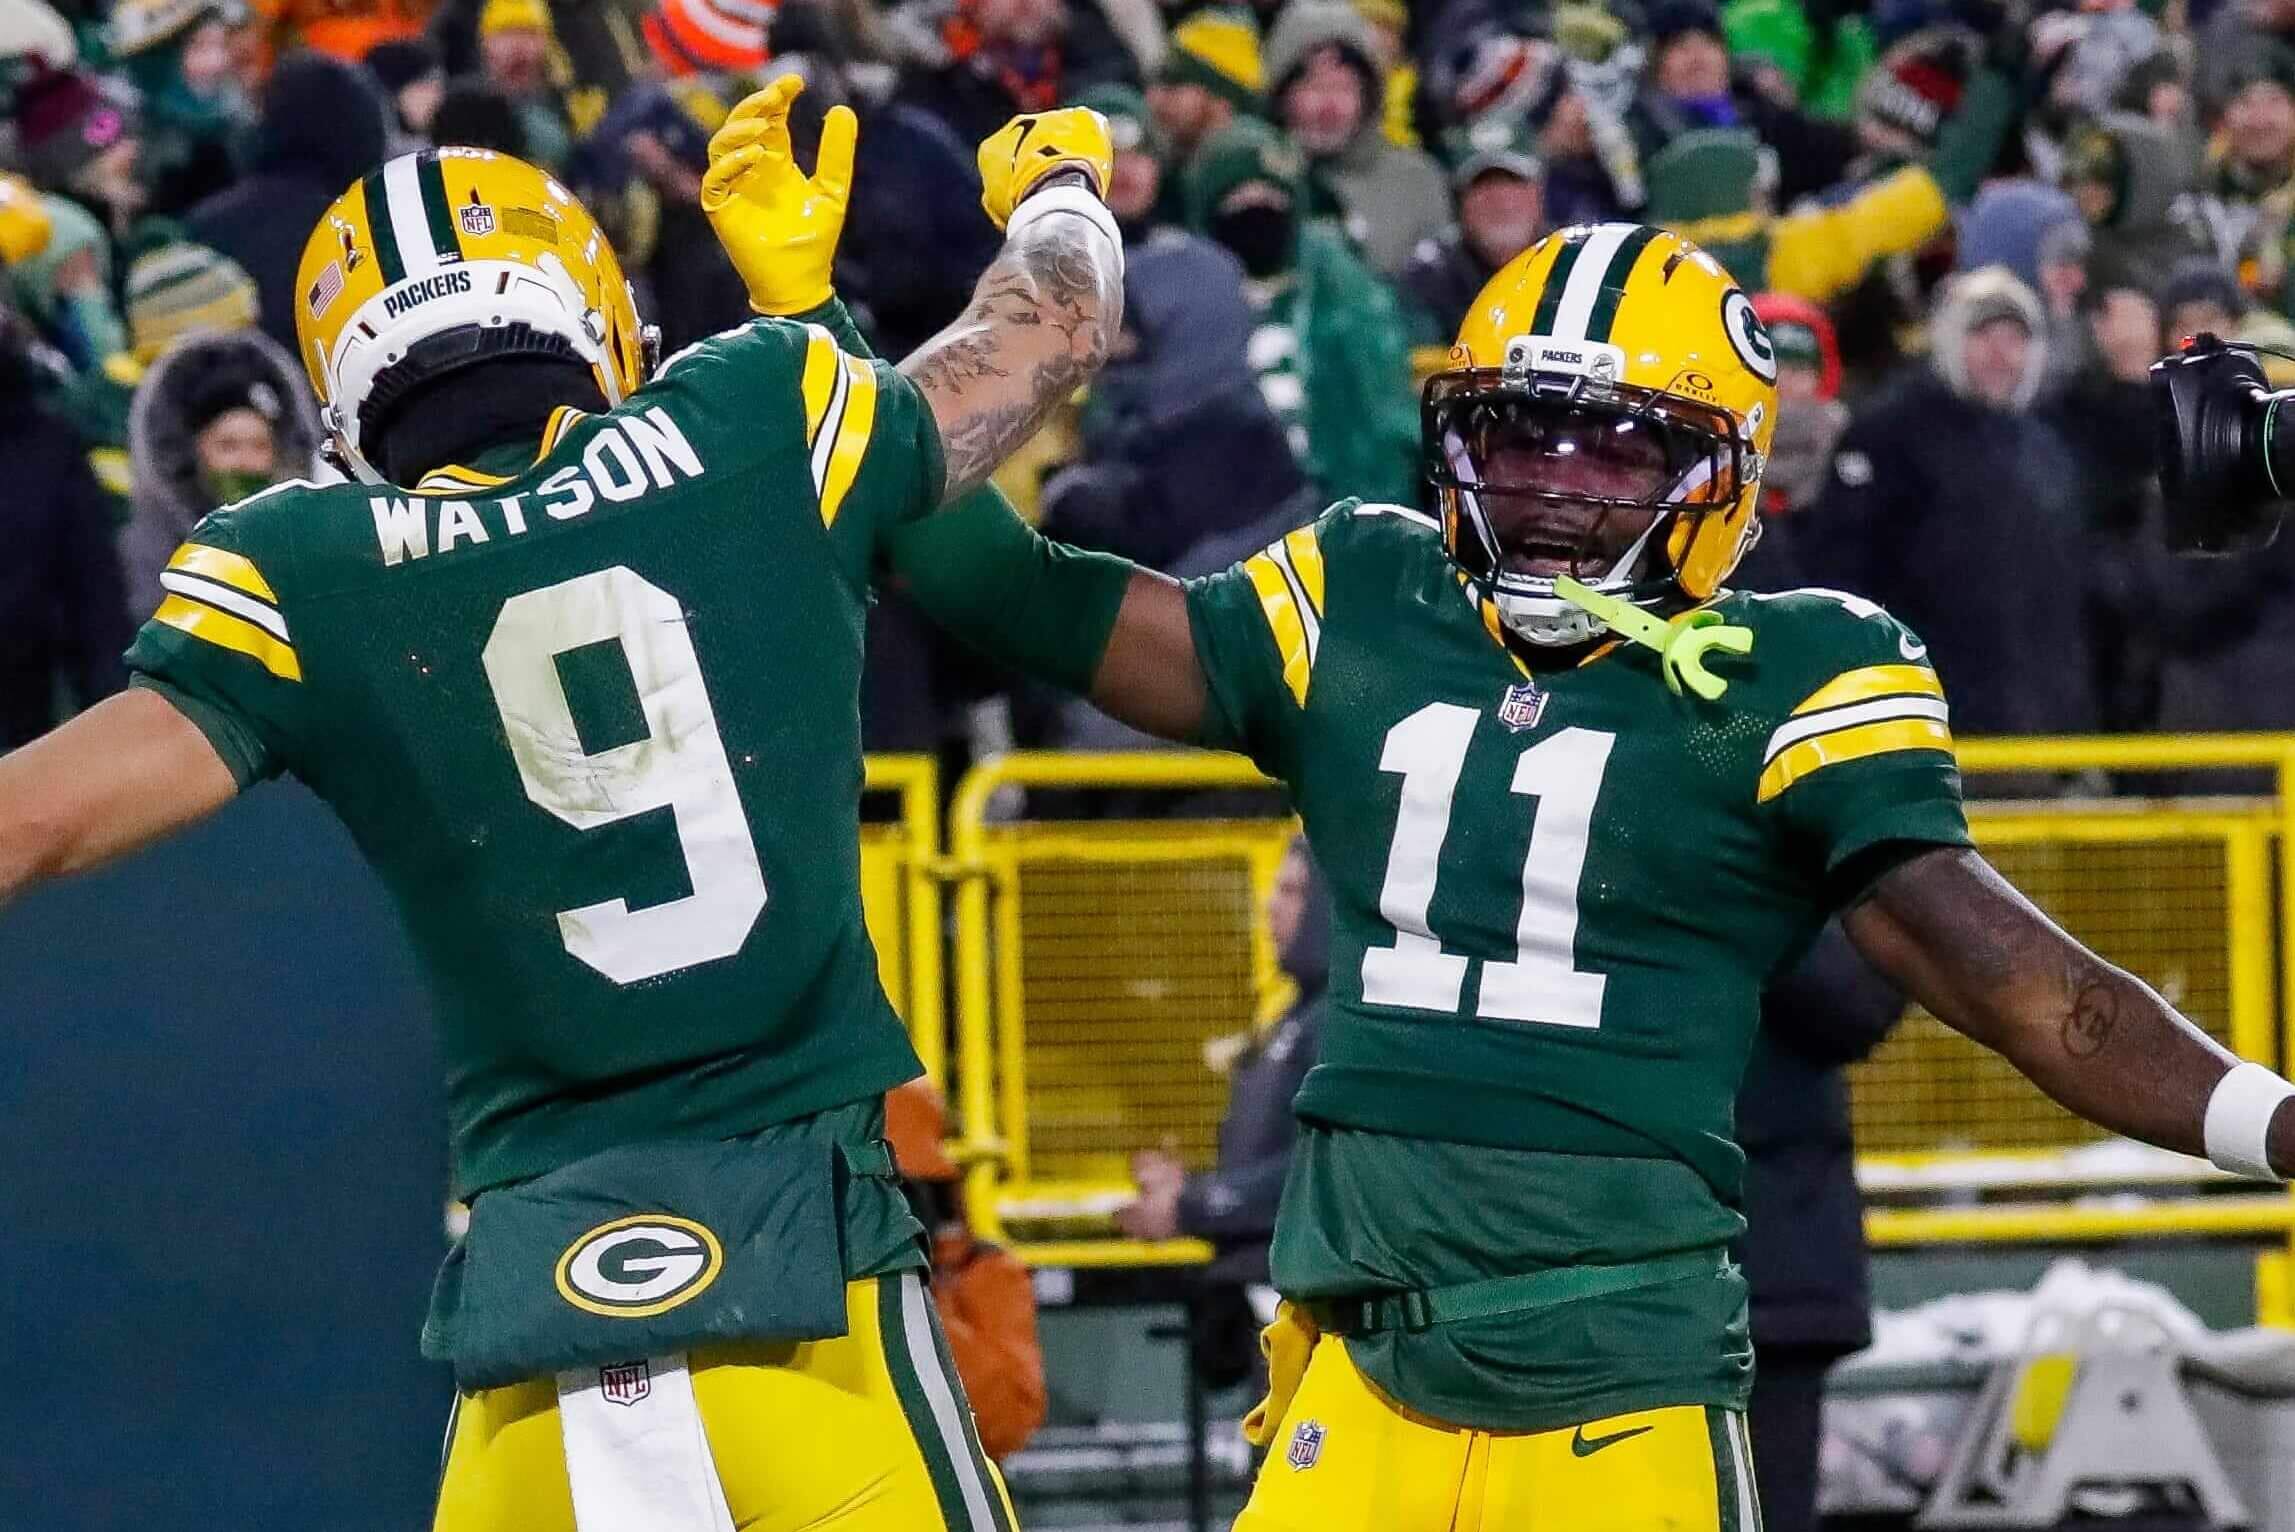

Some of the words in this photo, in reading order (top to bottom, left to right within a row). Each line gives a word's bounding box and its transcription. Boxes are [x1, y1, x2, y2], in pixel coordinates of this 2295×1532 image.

[464, 216, 491, 231] NFL
[384, 270, 471, 319] PACKERS
[1542, 349, 1583, 363] PACKERS
[370, 406, 705, 567] WATSON
[1505, 703, 1534, 723] NFL
[481, 565, 768, 985] 9
[1361, 701, 1616, 1029] 11
[570, 1227, 705, 1301] G
[607, 1368, 646, 1399] NFL
[1291, 1441, 1313, 1462] NFL
